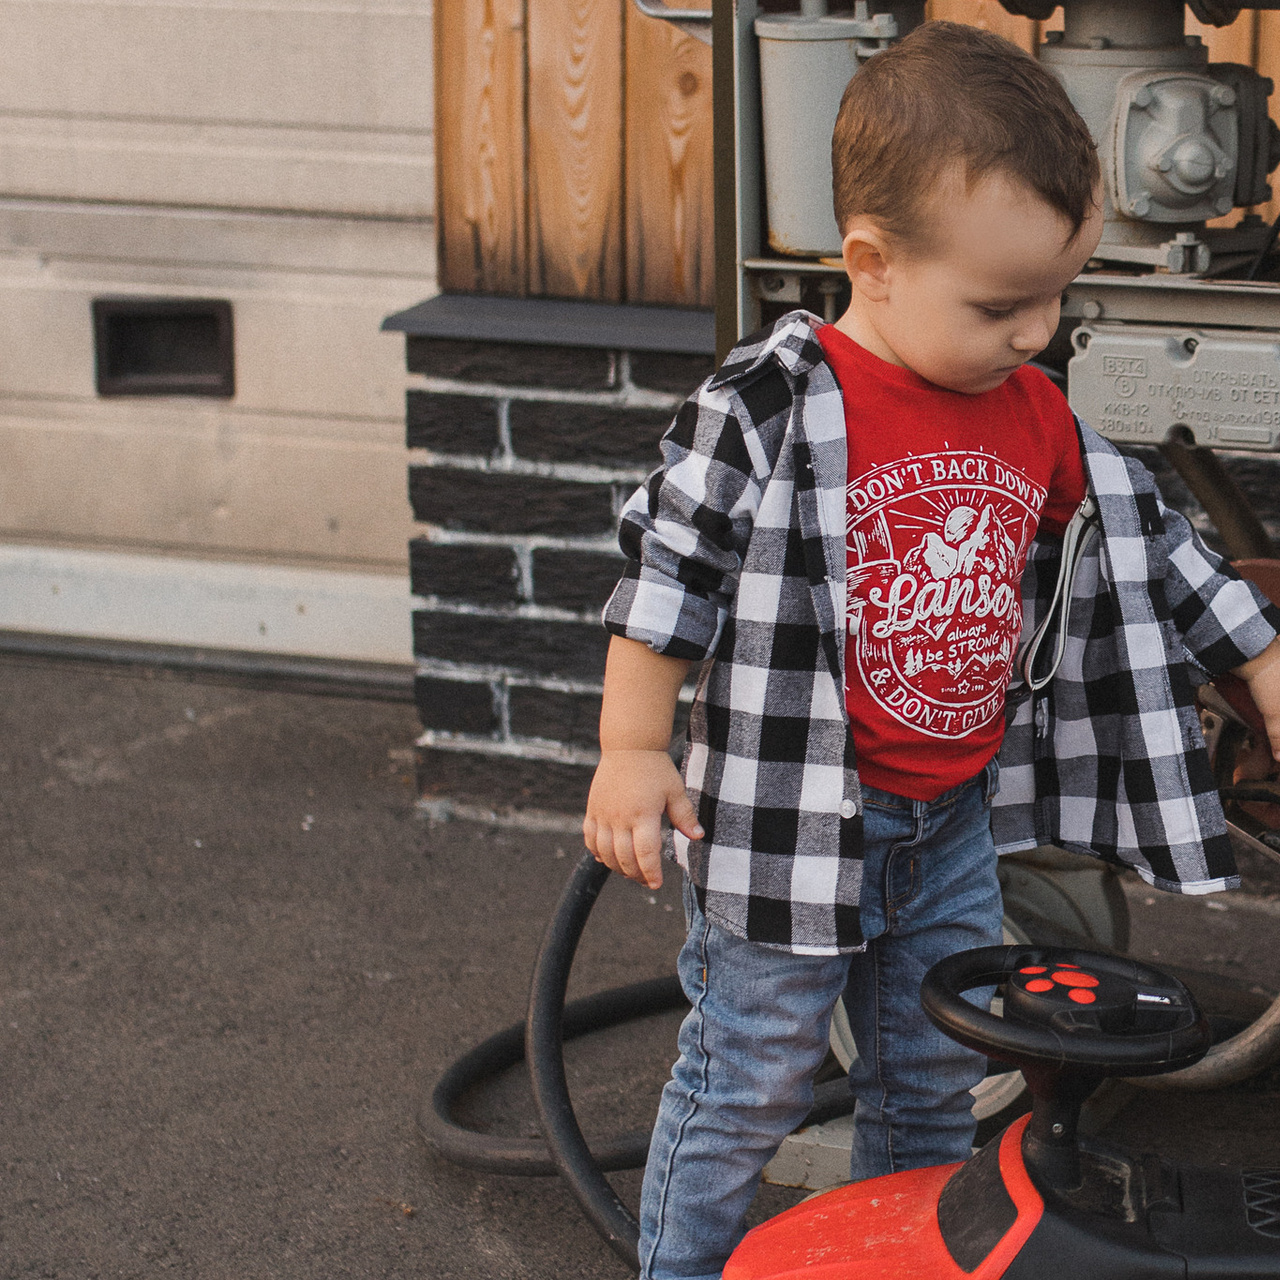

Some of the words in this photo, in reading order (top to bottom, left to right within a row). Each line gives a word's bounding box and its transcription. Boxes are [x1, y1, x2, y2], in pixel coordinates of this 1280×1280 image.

[1230, 388, 1249, 403] ОТ
[849, 462, 924, 512] DON'T
[930, 458, 989, 482] BACK
[994, 463, 1046, 511] DOWN
[925, 648, 945, 663] be
[948, 630, 1000, 658] STRONG
[946, 622, 987, 643] always
[869, 667, 892, 689] &
[884, 685, 957, 732] DON'T
[961, 693, 1000, 731] GIVE
